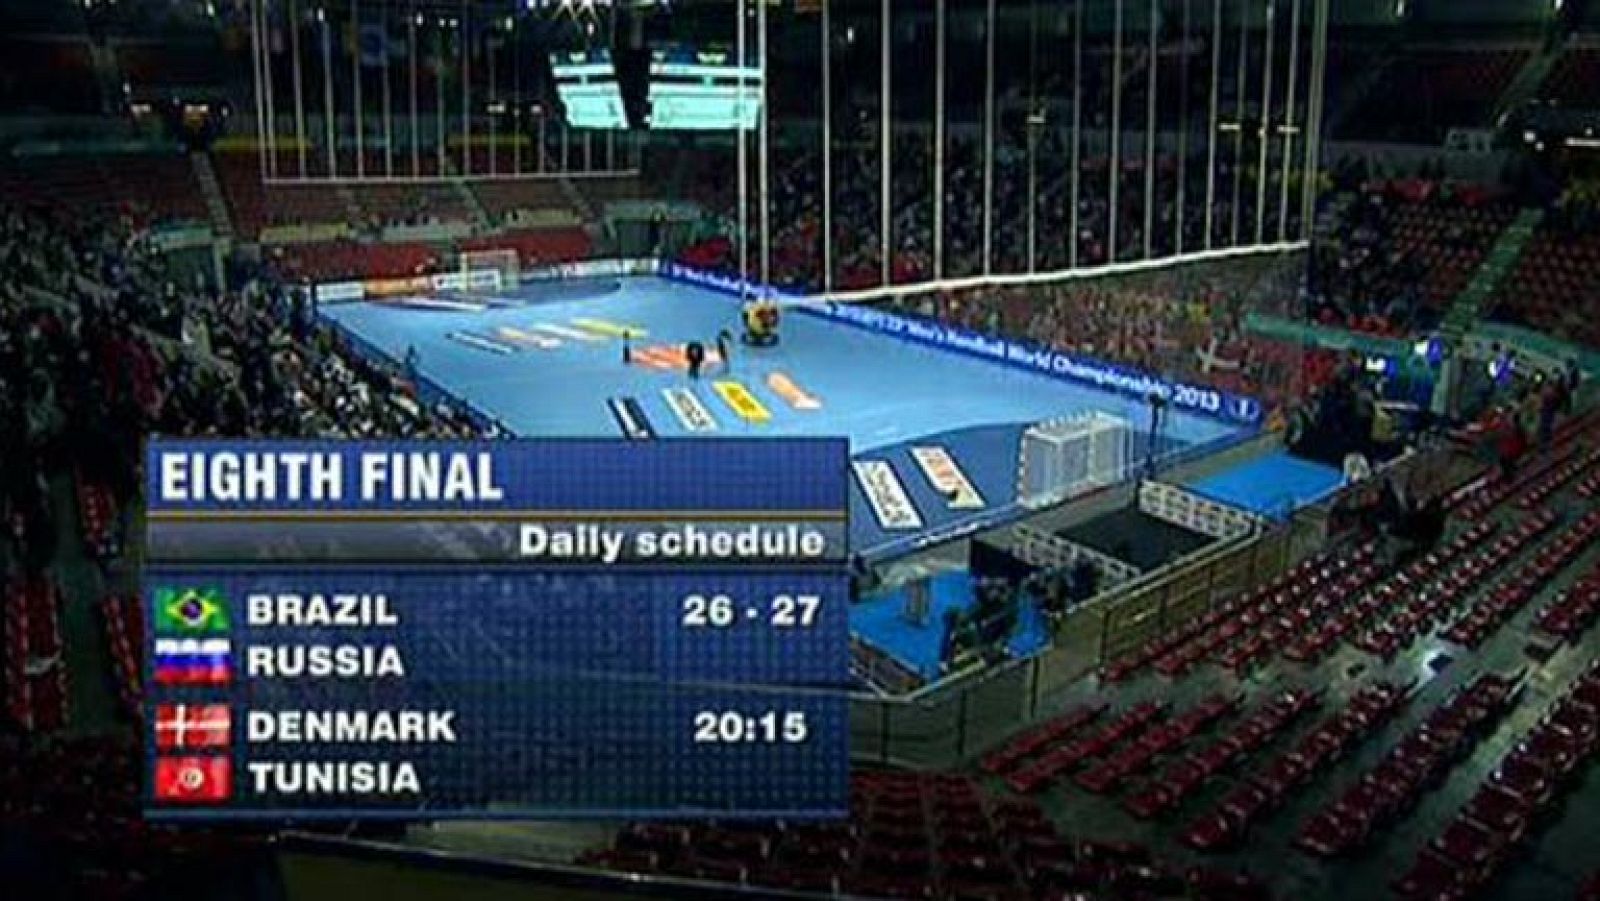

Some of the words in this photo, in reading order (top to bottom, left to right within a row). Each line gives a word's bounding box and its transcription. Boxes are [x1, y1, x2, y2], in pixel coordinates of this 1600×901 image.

[1007, 339, 1051, 370] World
[1053, 354, 1171, 398] Championship
[1173, 383, 1220, 411] 2013
